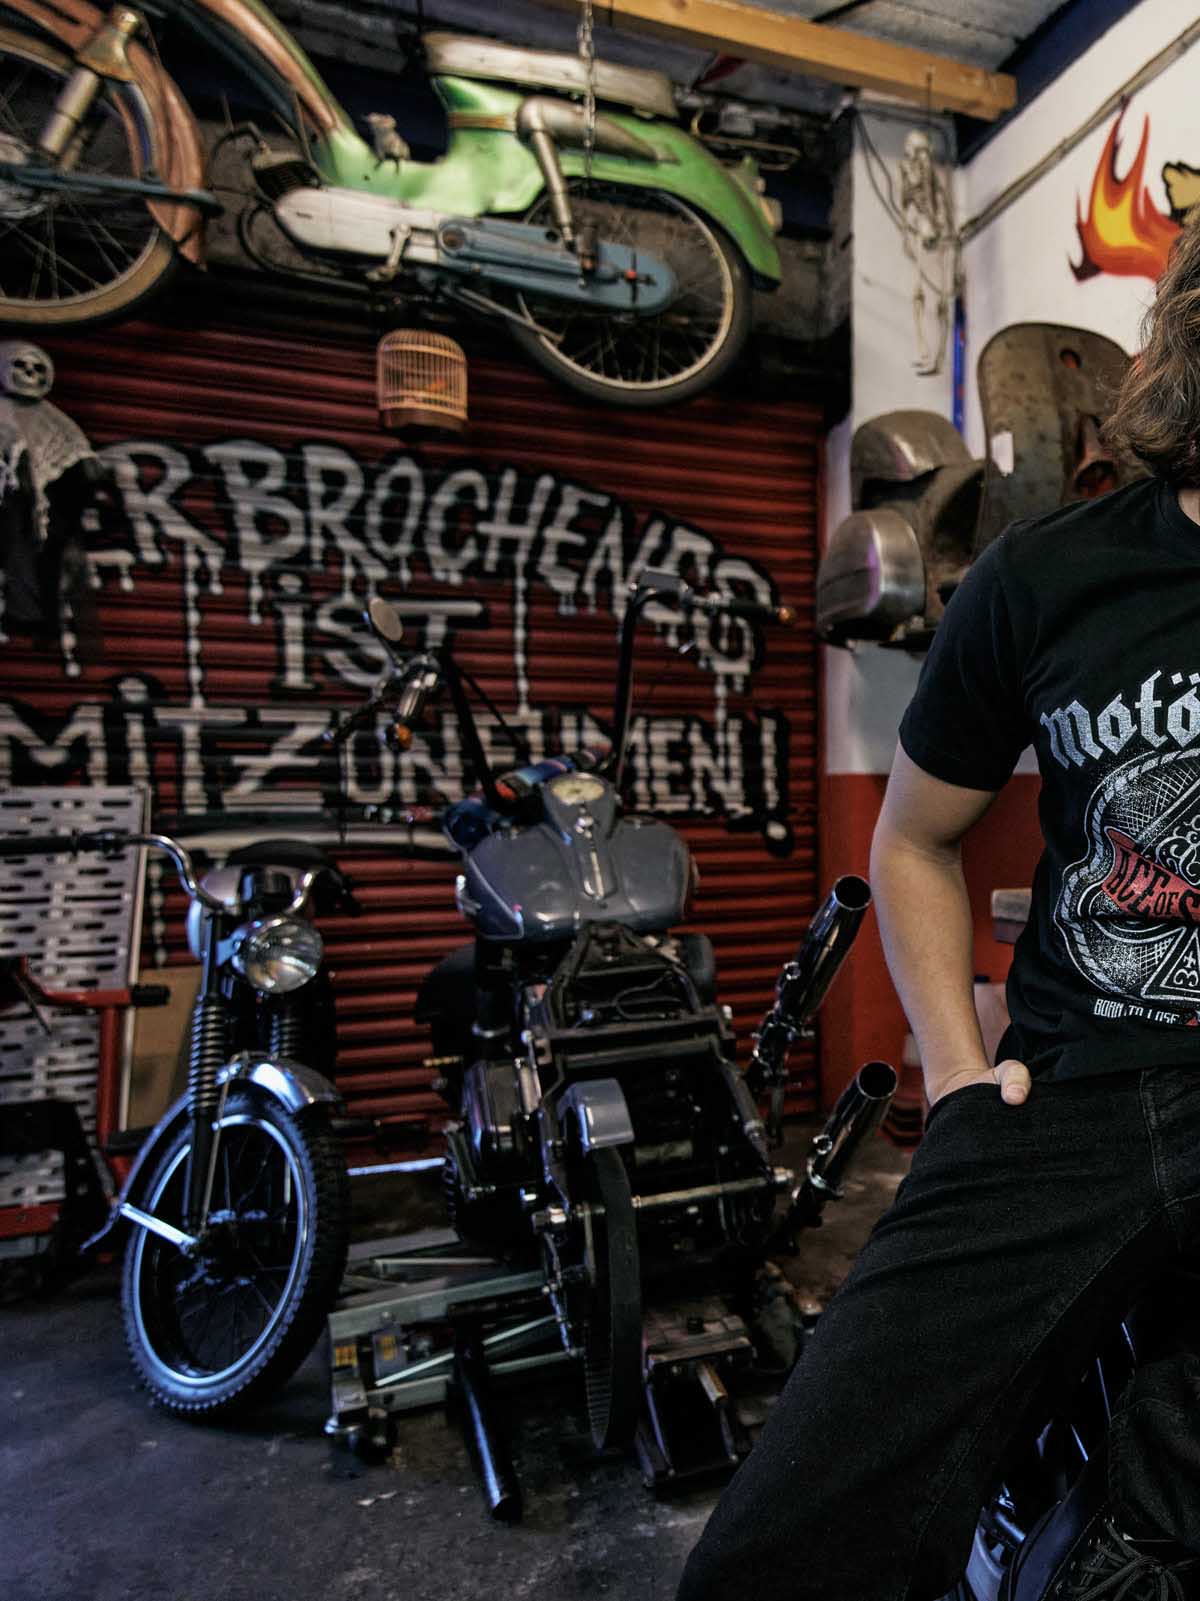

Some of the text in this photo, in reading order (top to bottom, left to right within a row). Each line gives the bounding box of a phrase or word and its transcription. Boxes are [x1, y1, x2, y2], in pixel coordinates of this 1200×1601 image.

[1105, 850, 1173, 916] ACE
[1154, 891, 1180, 916] OF
[1093, 998, 1124, 1019] BORN
[1127, 1004, 1144, 1017] TO
